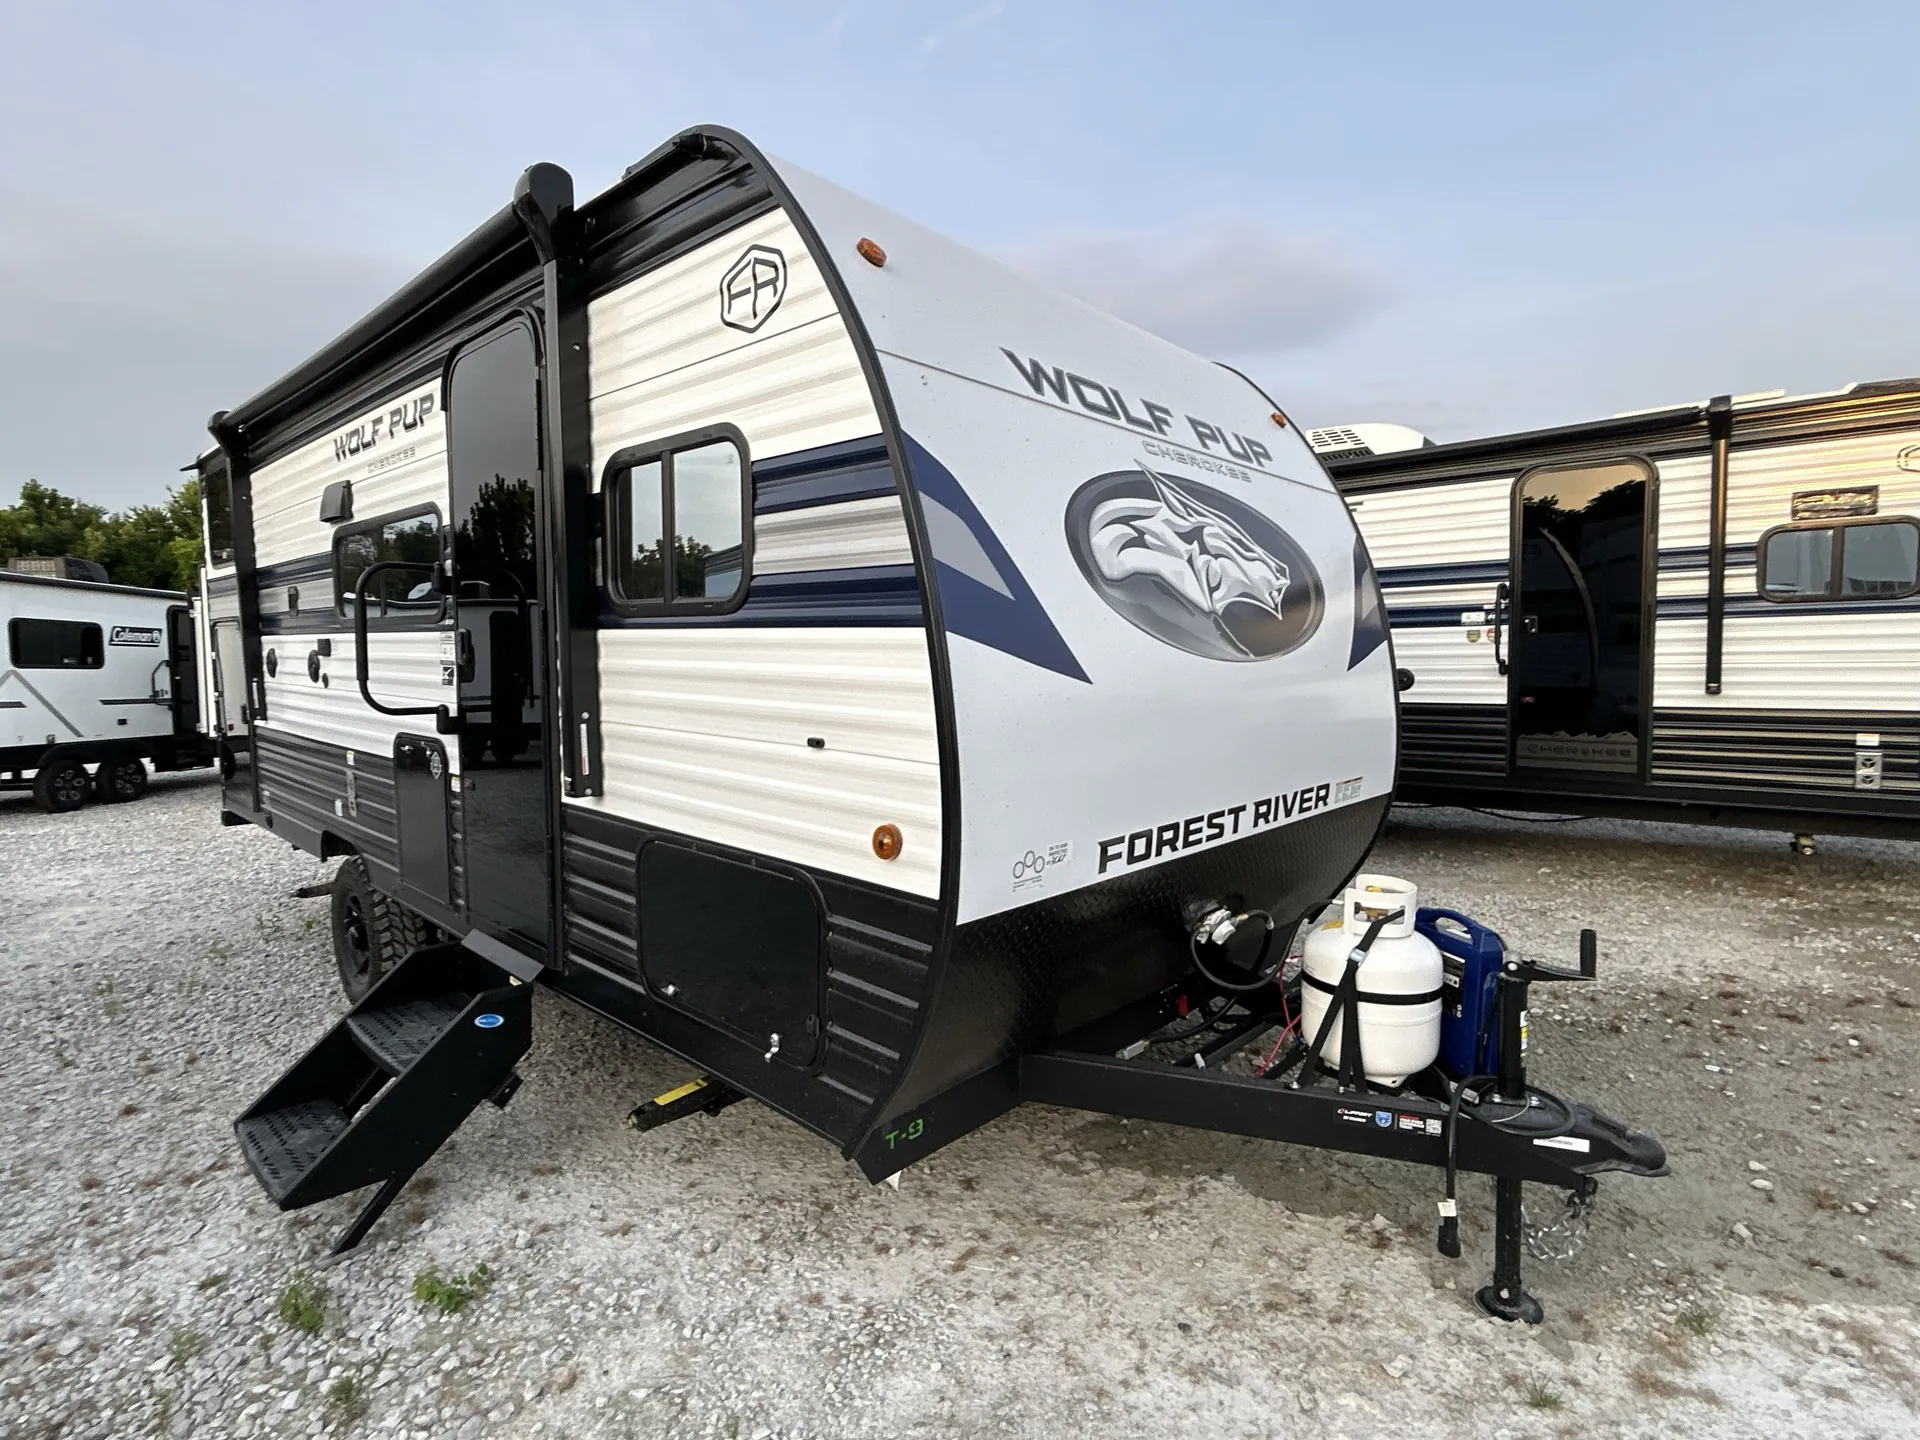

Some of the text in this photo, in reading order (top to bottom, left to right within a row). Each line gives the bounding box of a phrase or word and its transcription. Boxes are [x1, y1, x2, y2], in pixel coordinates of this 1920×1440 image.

[333, 393, 434, 462] WOLF PUP
[998, 346, 1273, 468] WOLF PUP
[1142, 440, 1251, 482] CHEROKEE
[112, 627, 152, 642] Coleman
[1097, 804, 1247, 875] FOREST
[1252, 783, 1330, 828] RIVER
